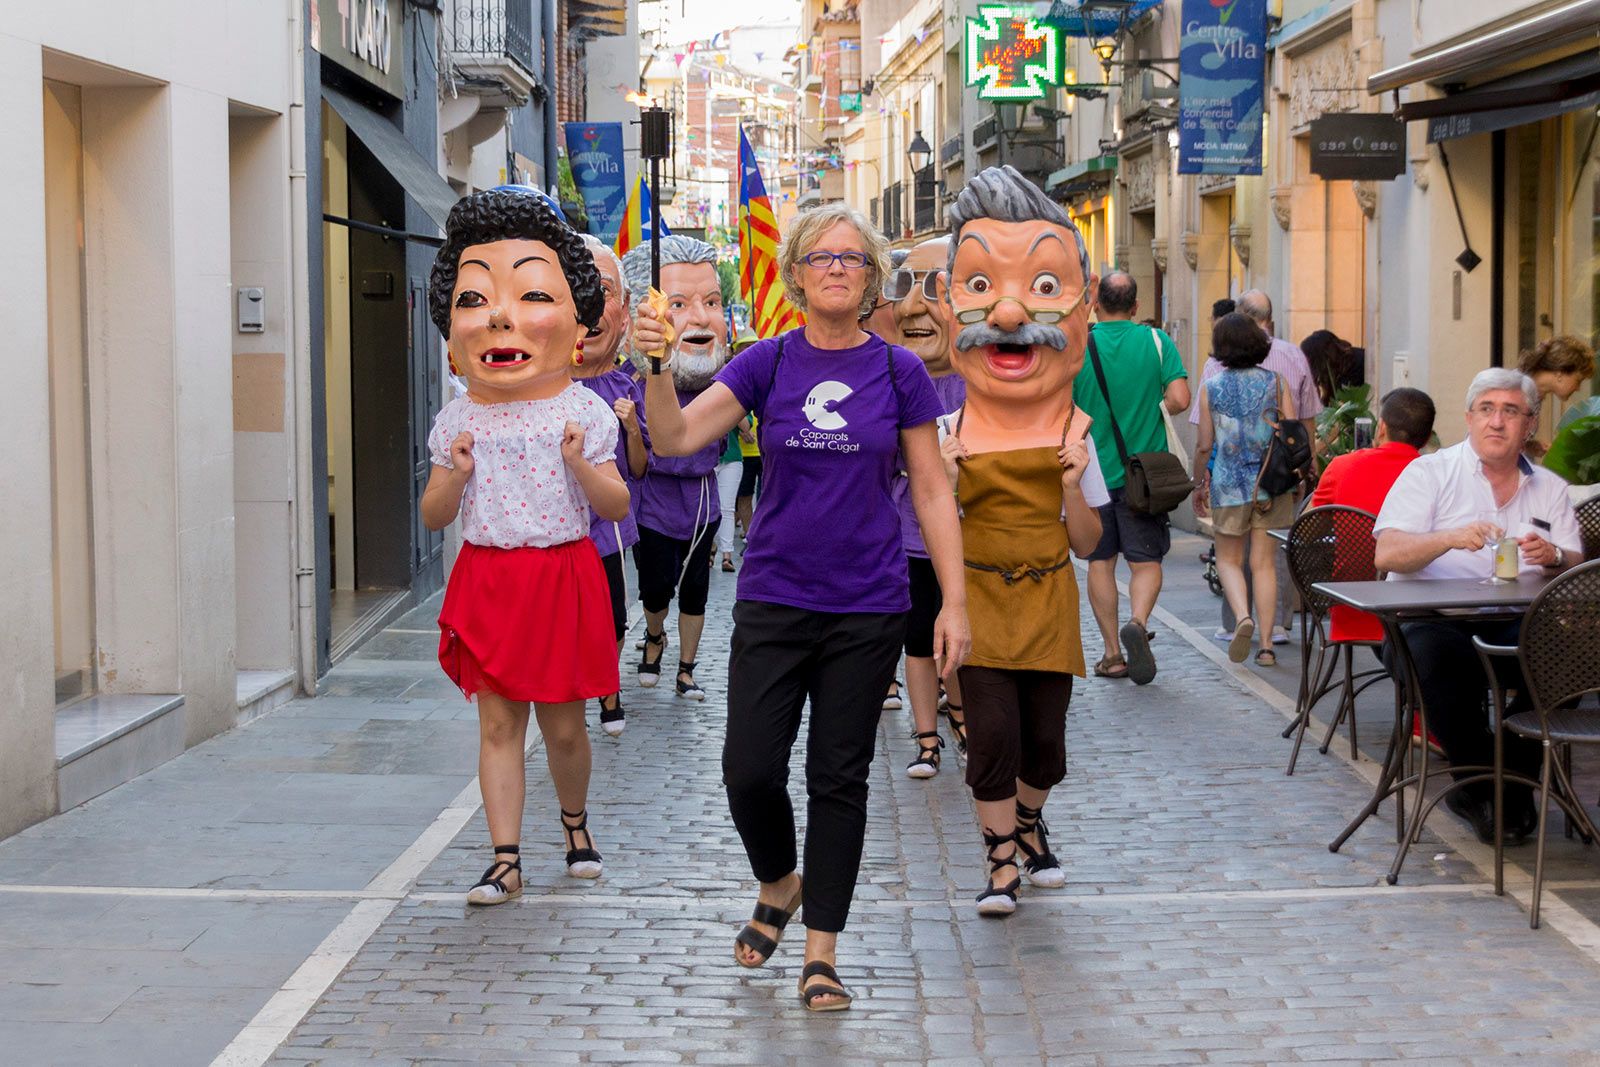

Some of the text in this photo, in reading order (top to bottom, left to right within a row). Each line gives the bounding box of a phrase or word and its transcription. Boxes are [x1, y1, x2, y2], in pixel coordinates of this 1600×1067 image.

[1186, 20, 1238, 38] Centre
[1213, 36, 1257, 59] Vila
[1183, 108, 1233, 118] comercial
[1183, 119, 1257, 132] de Sant Cugat
[1193, 142, 1249, 150] MODA INTIMA
[571, 149, 607, 160] Centre
[588, 158, 619, 174] Vila
[799, 428, 849, 441] Caparrots
[785, 436, 860, 453] de Sant Cugat
